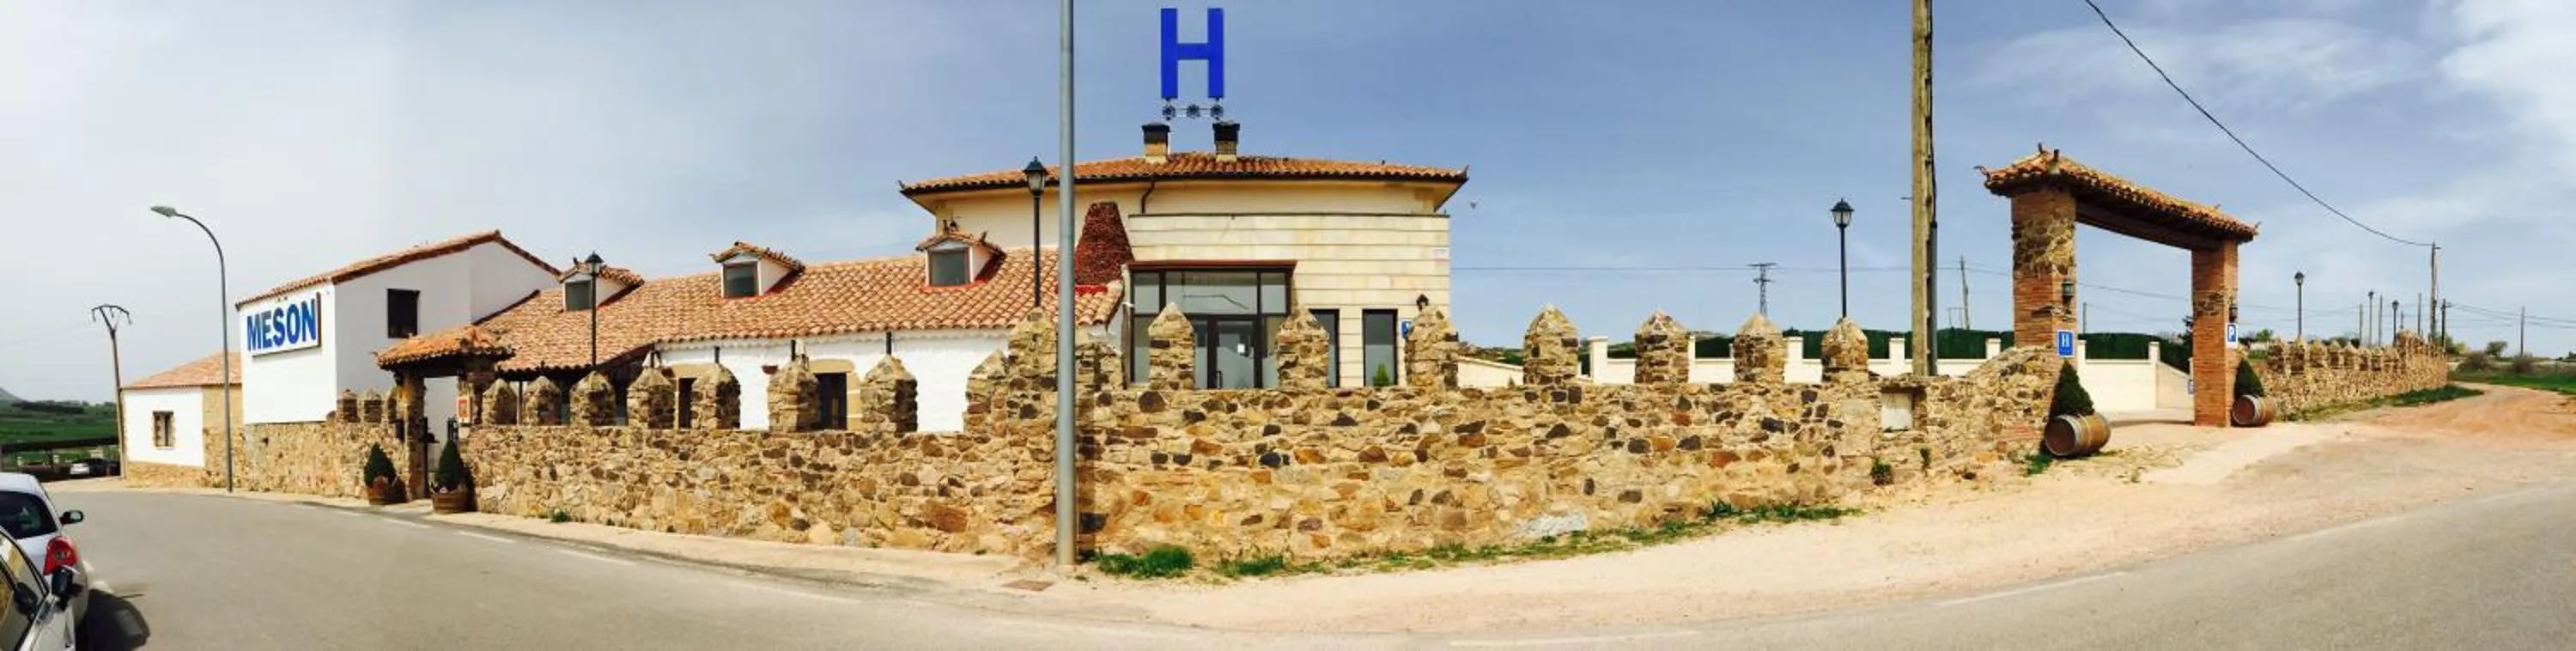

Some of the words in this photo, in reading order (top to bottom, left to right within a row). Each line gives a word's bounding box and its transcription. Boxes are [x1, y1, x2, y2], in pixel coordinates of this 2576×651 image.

[1161, 8, 1224, 99] H
[246, 298, 316, 350] MESON
[2062, 333, 2070, 347] H
[2228, 326, 2235, 340] P
